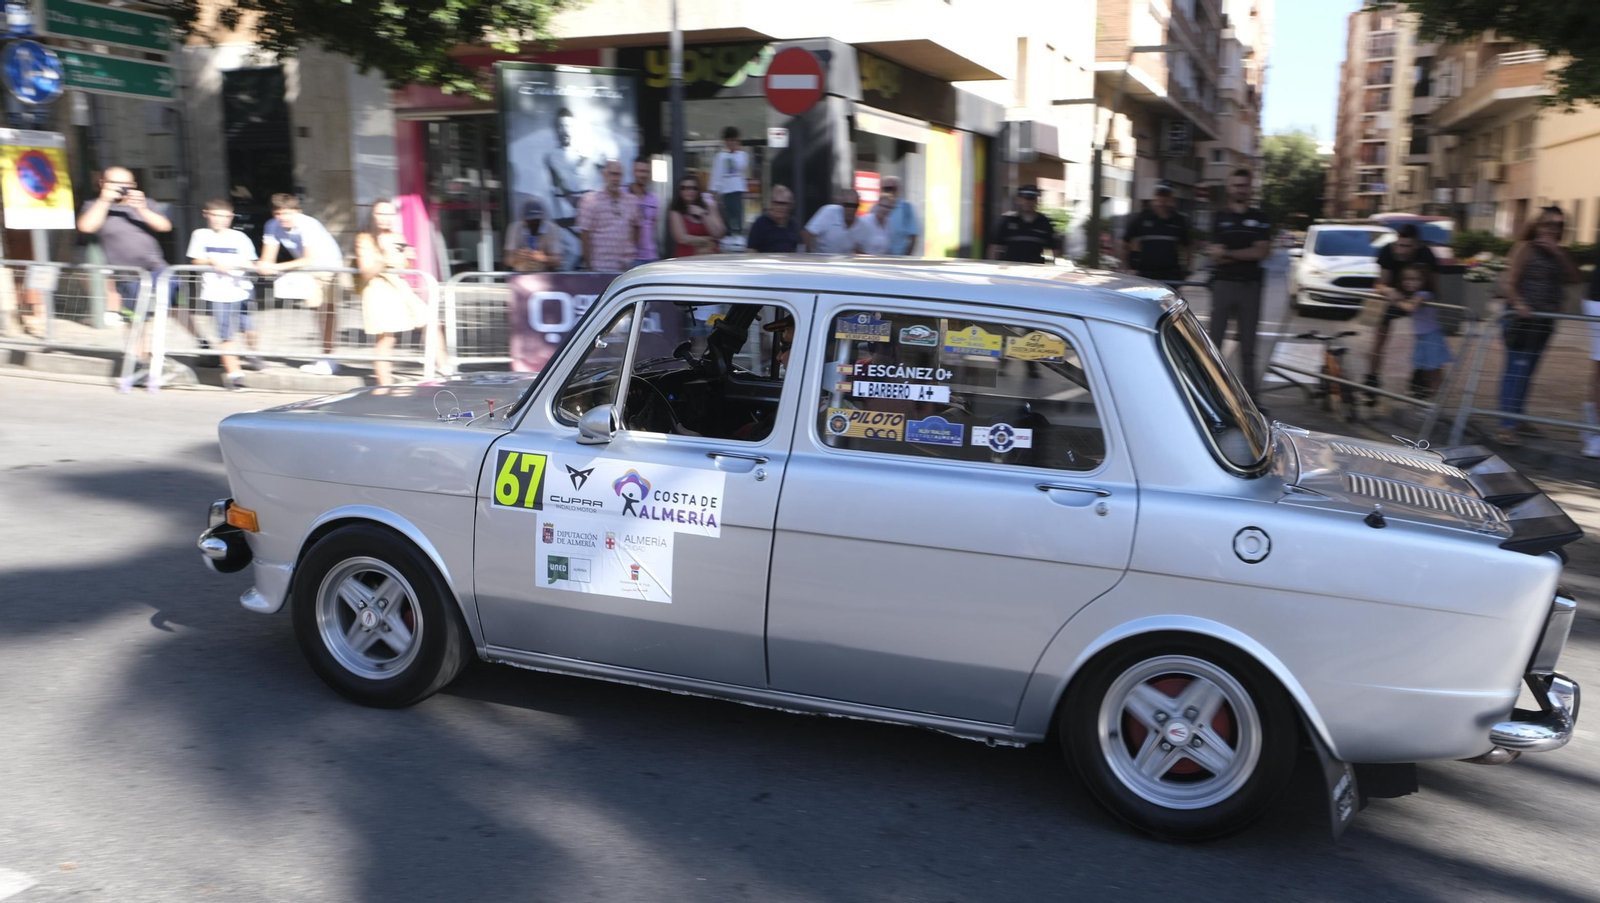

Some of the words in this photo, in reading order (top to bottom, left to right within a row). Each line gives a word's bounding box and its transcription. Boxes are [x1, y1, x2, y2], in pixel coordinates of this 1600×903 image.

[1030, 334, 1042, 342] 47
[854, 364, 865, 376] F.
[867, 363, 934, 380] ESCÁNEZ
[858, 382, 866, 396] L.
[918, 386, 934, 400] A+
[850, 411, 903, 426] PILOTO
[495, 452, 547, 508] 67
[550, 495, 603, 508] CUPRA
[654, 490, 697, 505] COSTA
[701, 496, 718, 508] DE
[555, 504, 577, 512] INDALO
[639, 505, 718, 528] ALMERÍA
[557, 530, 598, 541] DIPUTACIÓN
[624, 534, 667, 548] ALMERÍA
[566, 538, 596, 548] ALMERÍA
[624, 544, 646, 552] CIUDAD
